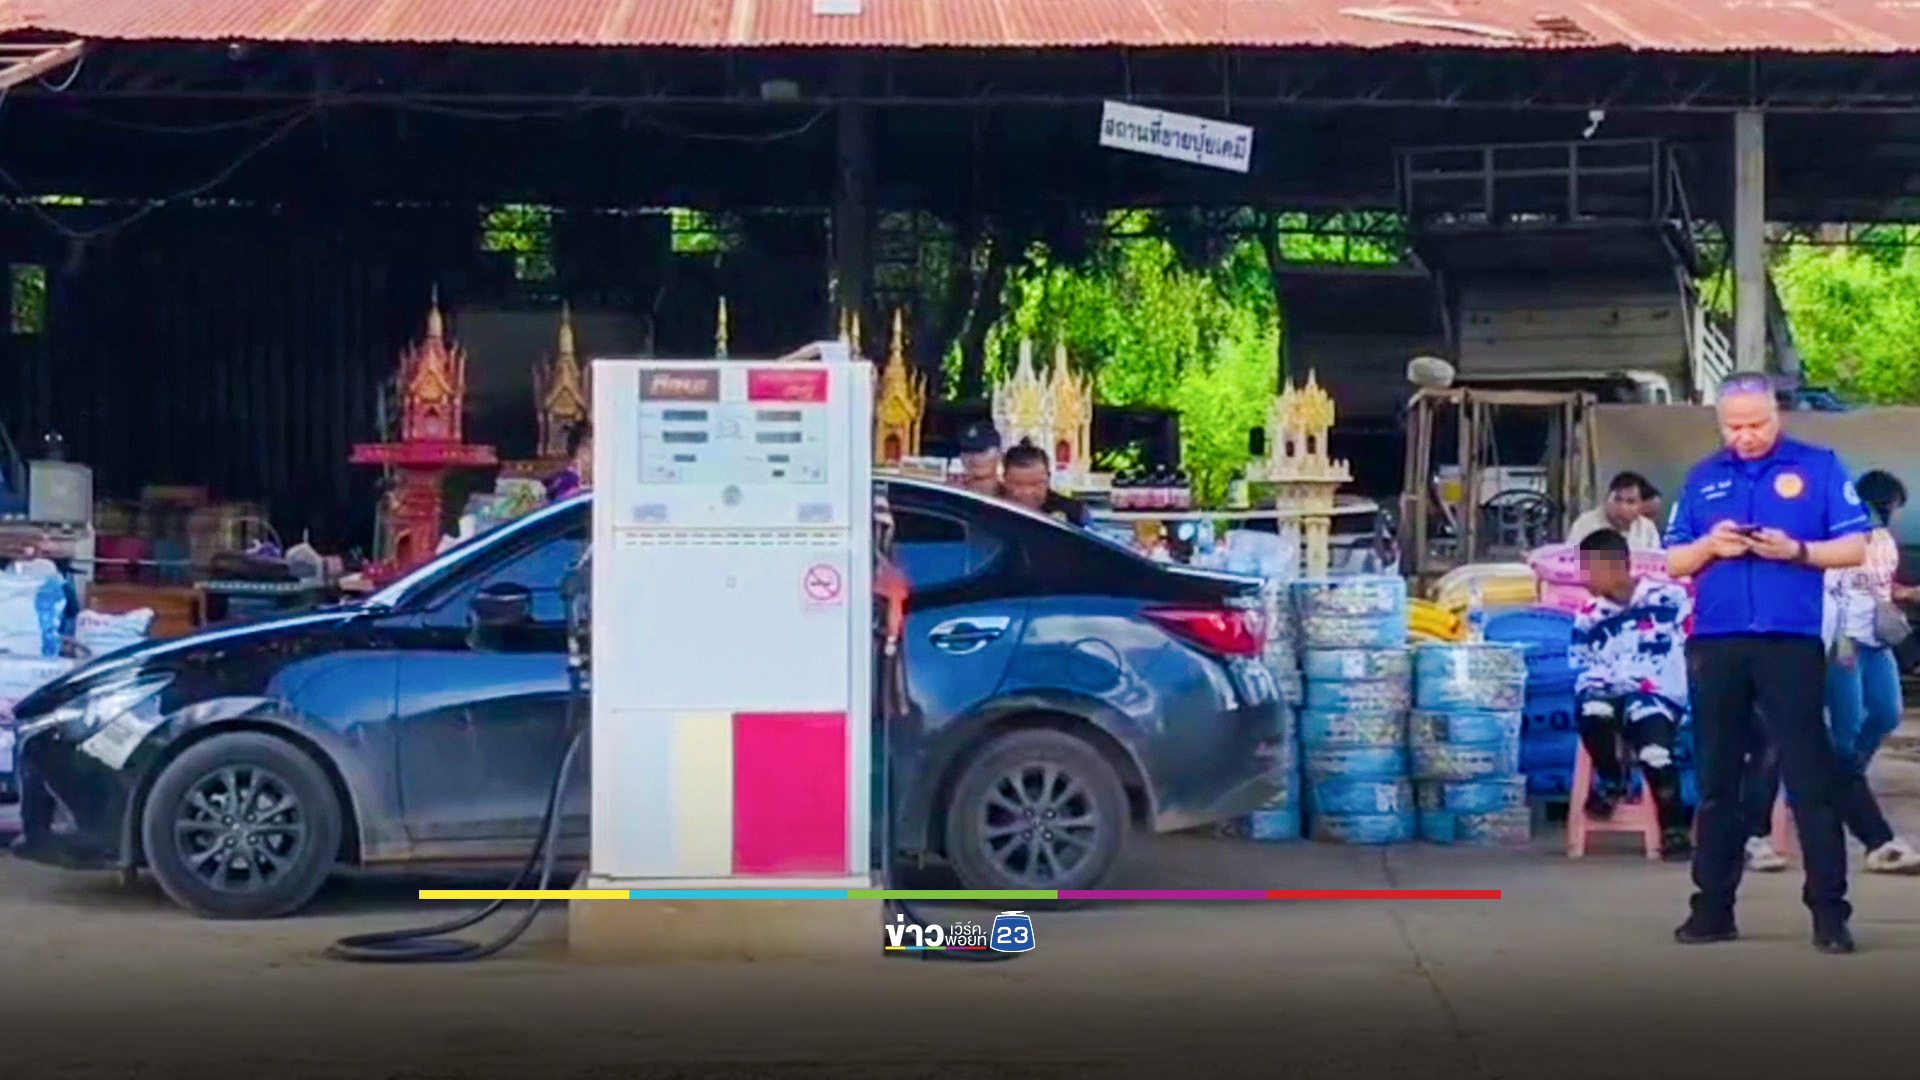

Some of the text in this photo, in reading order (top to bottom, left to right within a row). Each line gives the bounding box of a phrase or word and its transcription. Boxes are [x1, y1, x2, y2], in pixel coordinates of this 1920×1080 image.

[1103, 113, 1248, 163] สถานที่ขายปุ๋ยเคมี
